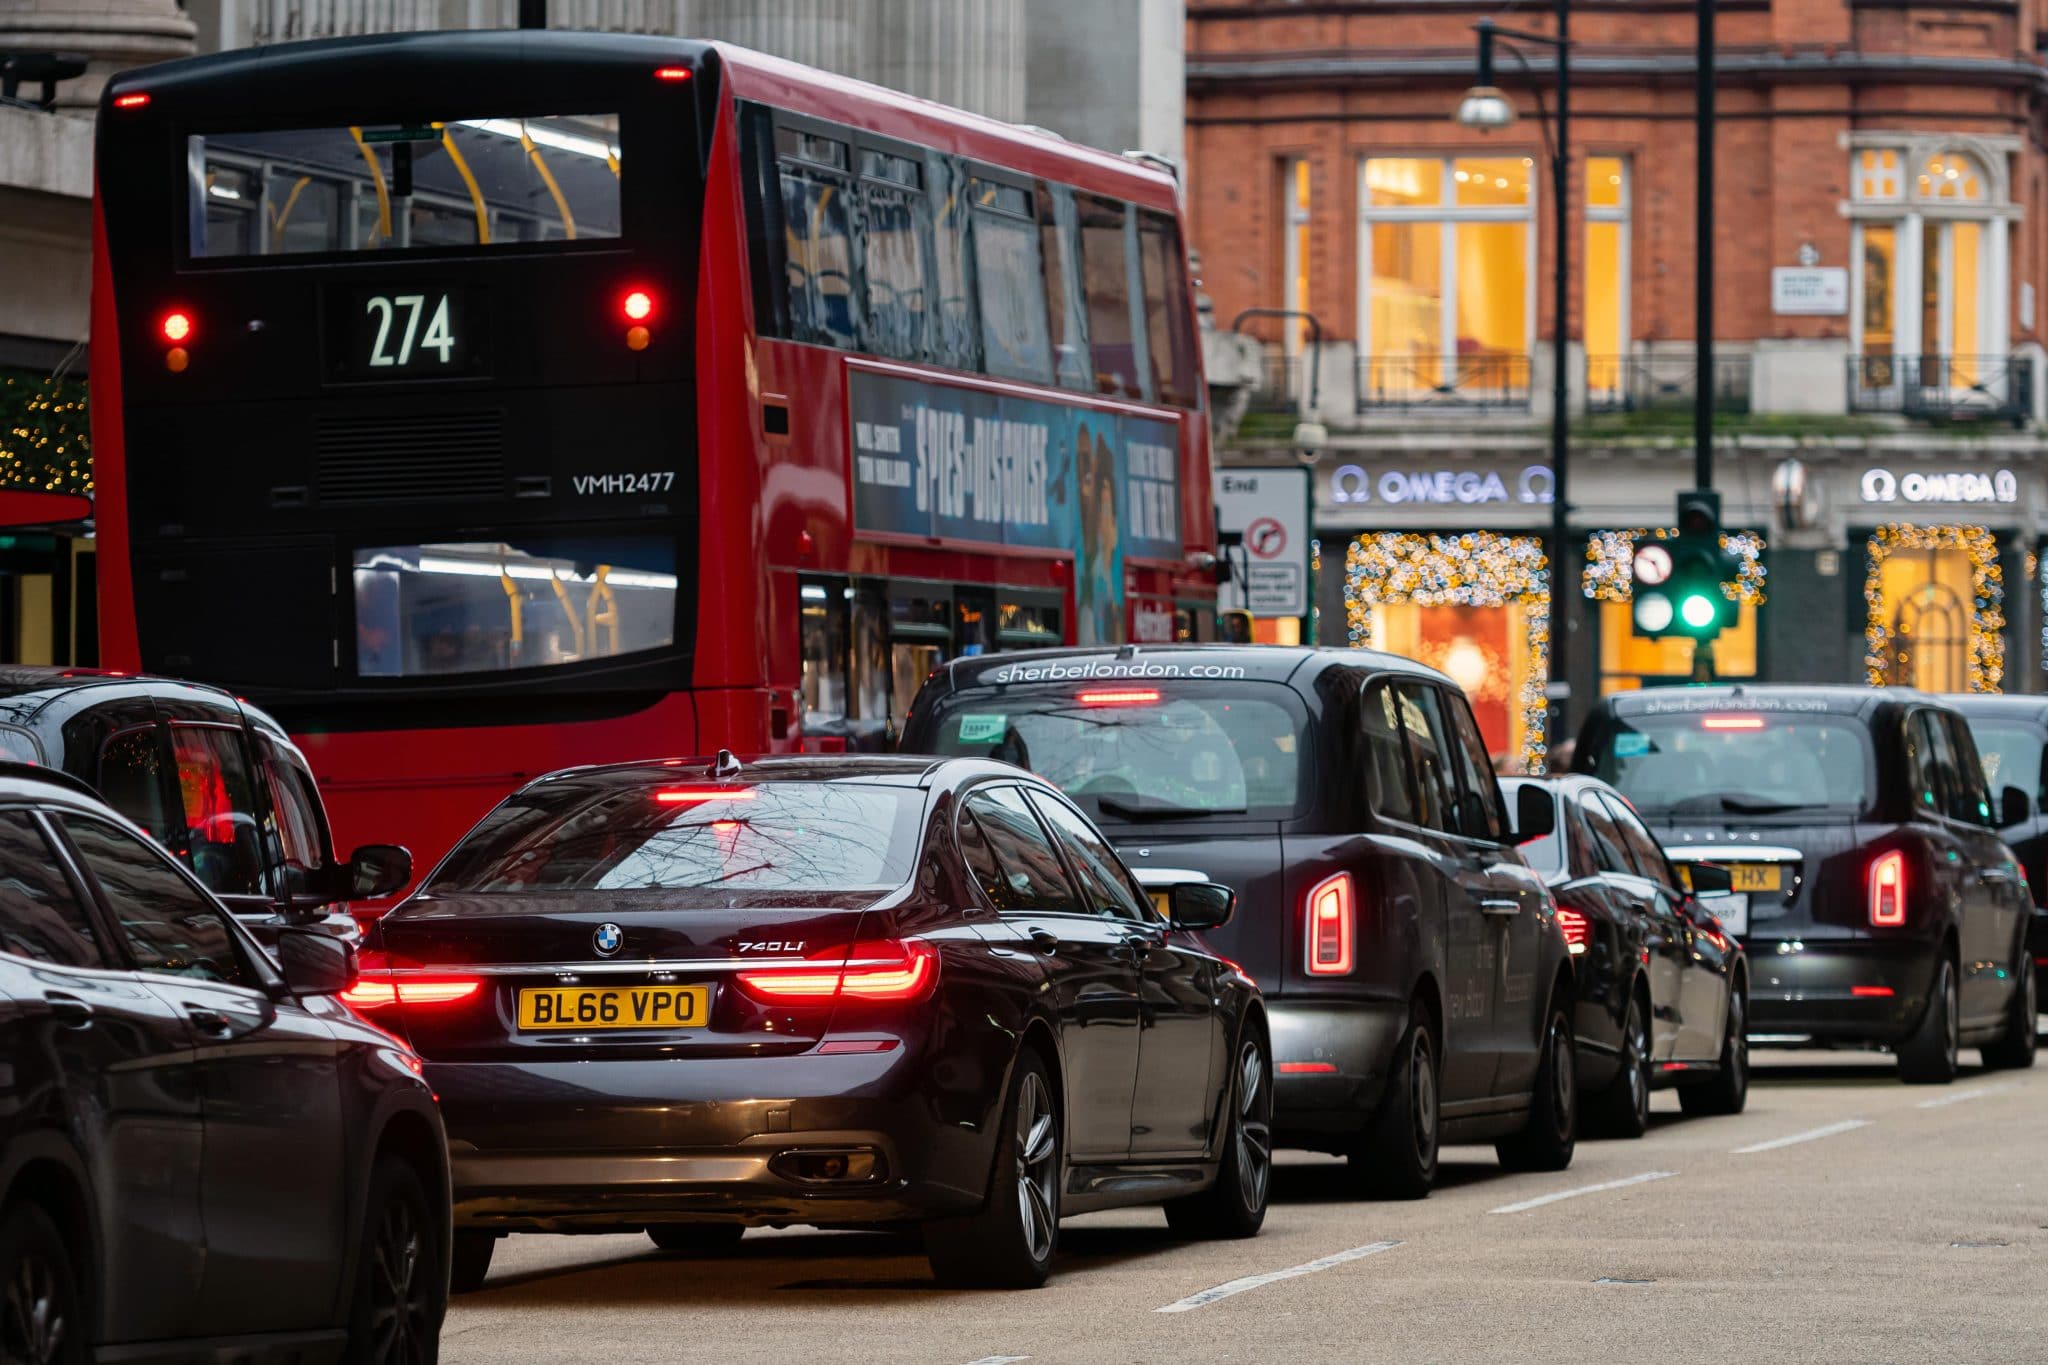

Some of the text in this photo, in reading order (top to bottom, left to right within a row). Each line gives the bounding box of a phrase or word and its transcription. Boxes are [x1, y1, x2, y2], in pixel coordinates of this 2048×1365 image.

[367, 294, 455, 366] 274
[916, 405, 964, 518] SPIES
[973, 416, 1048, 525] DISGUISE
[573, 471, 675, 495] VMH2477
[1222, 477, 1258, 493] End
[1378, 471, 1508, 503] OMEGA
[1900, 473, 1995, 502] OMEGA
[996, 660, 1245, 683] sherbetlondon.com
[533, 990, 695, 1024] BL66 VPO
